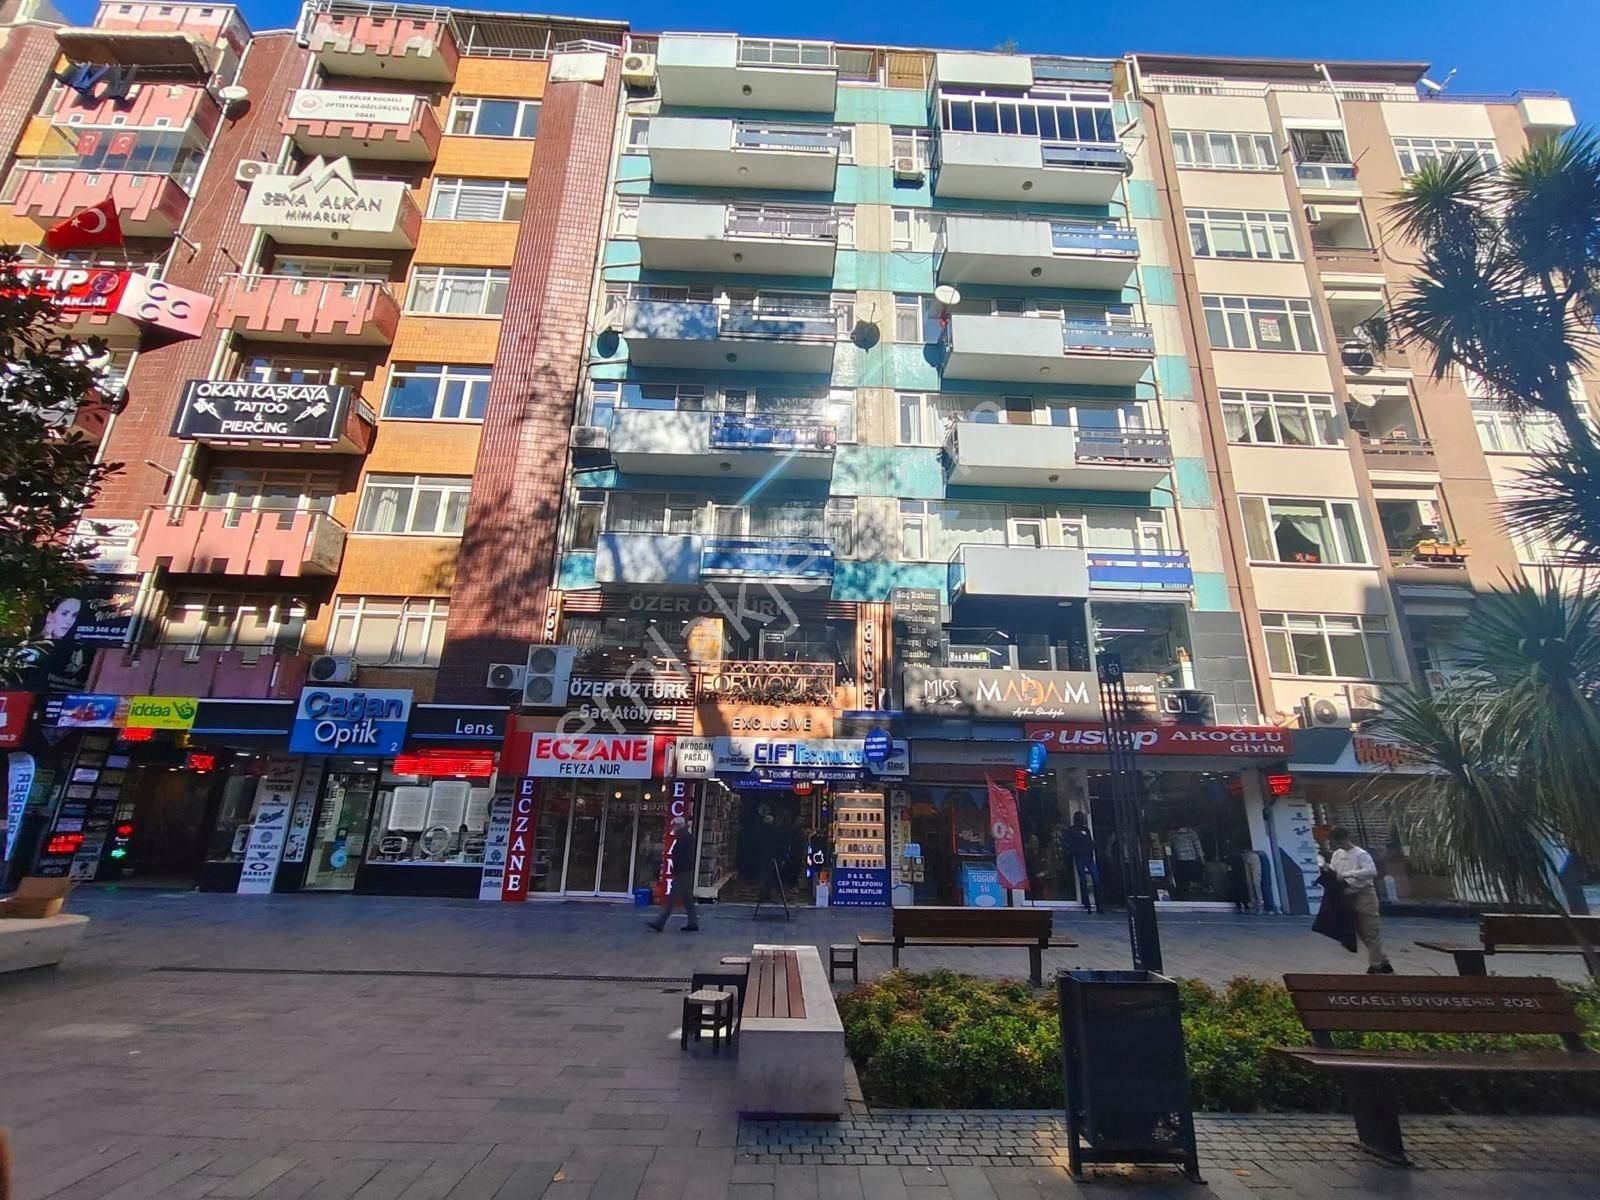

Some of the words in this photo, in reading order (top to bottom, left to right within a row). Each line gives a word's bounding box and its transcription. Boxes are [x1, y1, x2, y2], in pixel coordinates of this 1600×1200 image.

[262, 191, 308, 208] SENA
[319, 195, 383, 212] ALKAN
[196, 383, 249, 398] OKAN
[251, 385, 330, 402] KAŞKAYA
[233, 400, 288, 414] TATTOO
[254, 412, 263, 421] &
[220, 420, 288, 434] PIERCING
[630, 592, 690, 613] ÖZER
[569, 677, 615, 698] ÖZER
[619, 679, 690, 699] ÖZTÜRK
[924, 679, 960, 698] MISS
[976, 678, 1090, 706] MADAM
[130, 702, 171, 717] iddaa
[579, 703, 610, 722] Saç
[611, 704, 678, 724] Atölyesi
[455, 718, 494, 735] Lens
[731, 716, 812, 732] EXCLUSIVE
[314, 718, 379, 748] Optik
[1171, 729, 1282, 743] AKOĞLU
[390, 742, 398, 752] 2
[535, 738, 649, 762] ECZANE
[559, 762, 595, 775] FEYZA
[599, 764, 621, 776] NUR
[507, 779, 535, 892] ECZANE
[979, 885, 990, 893] SU
[1503, 997, 1542, 1009] 2021
